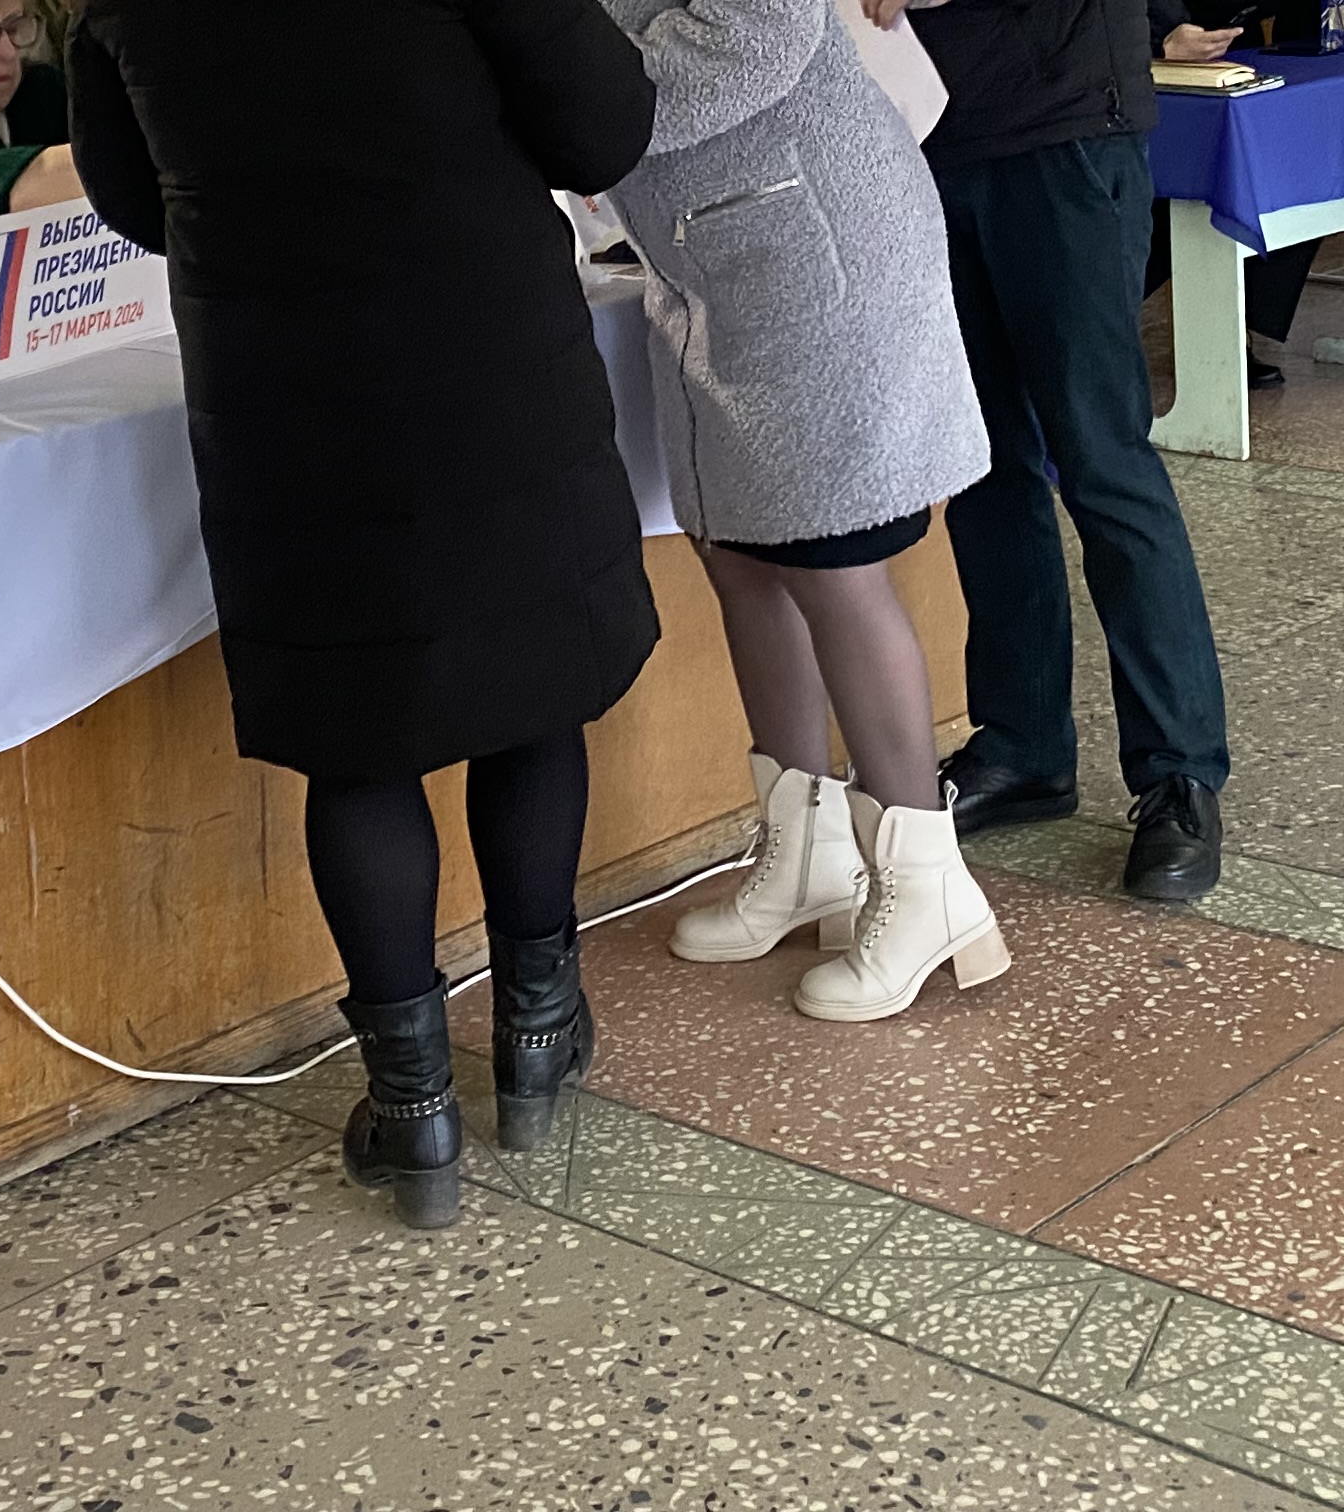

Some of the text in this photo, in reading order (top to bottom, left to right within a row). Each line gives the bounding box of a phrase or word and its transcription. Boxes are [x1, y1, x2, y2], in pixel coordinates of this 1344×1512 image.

[40, 212, 111, 248] ВЫБОР
[28, 277, 105, 321] РОССИИ
[66, 311, 111, 342] МАРТА
[113, 299, 145, 328] 2024
